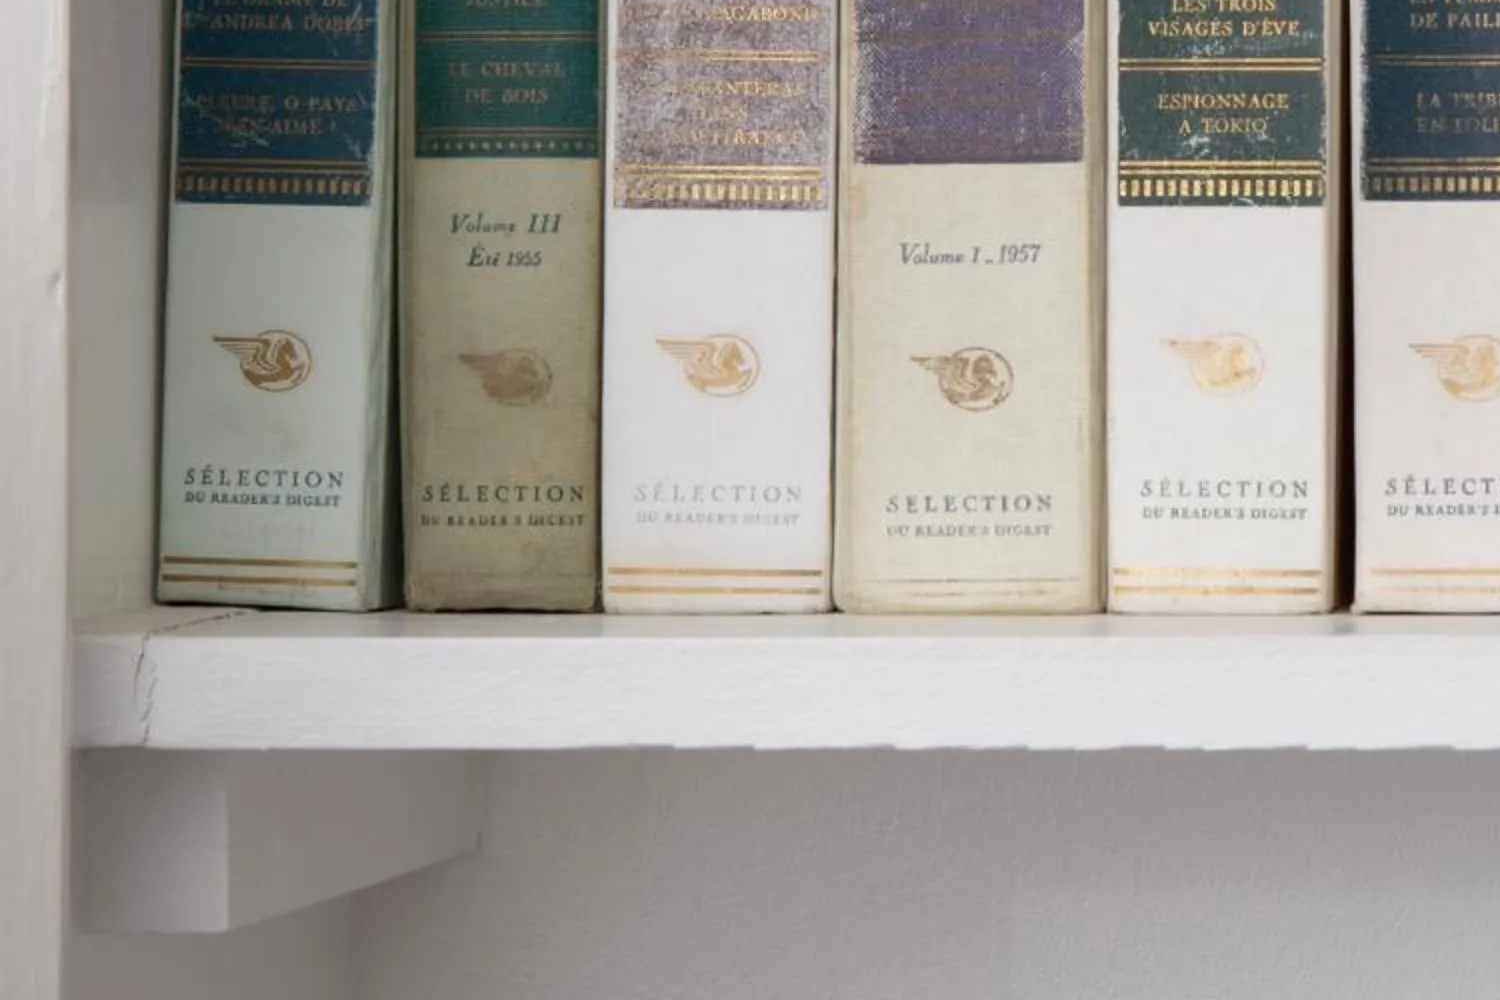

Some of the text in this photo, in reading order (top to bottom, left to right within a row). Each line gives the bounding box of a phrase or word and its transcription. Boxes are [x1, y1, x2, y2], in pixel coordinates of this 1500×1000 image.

[1410, 13, 1438, 28] DE
[1148, 21, 1233, 37] VISAGES
[1158, 93, 1289, 109] ESPIONNAGE
[1416, 92, 1441, 108] LA
[1203, 117, 1267, 134] TOKIO
[450, 212, 562, 234] Volume III
[506, 250, 543, 267] 1955
[900, 243, 965, 264] Volume
[1000, 244, 1041, 264] 1957
[184, 464, 344, 488] SÉLECTION
[422, 482, 584, 503] SÉLECTION
[634, 482, 801, 503] SÉLECTION
[1140, 477, 1308, 499] SÉLECTION
[185, 492, 205, 503] DU
[286, 494, 341, 508] DIGEST
[1142, 507, 1164, 519] DU
[1251, 508, 1308, 520] DIGEST
[1387, 504, 1409, 516] DU
[528, 515, 584, 526] DIGEST
